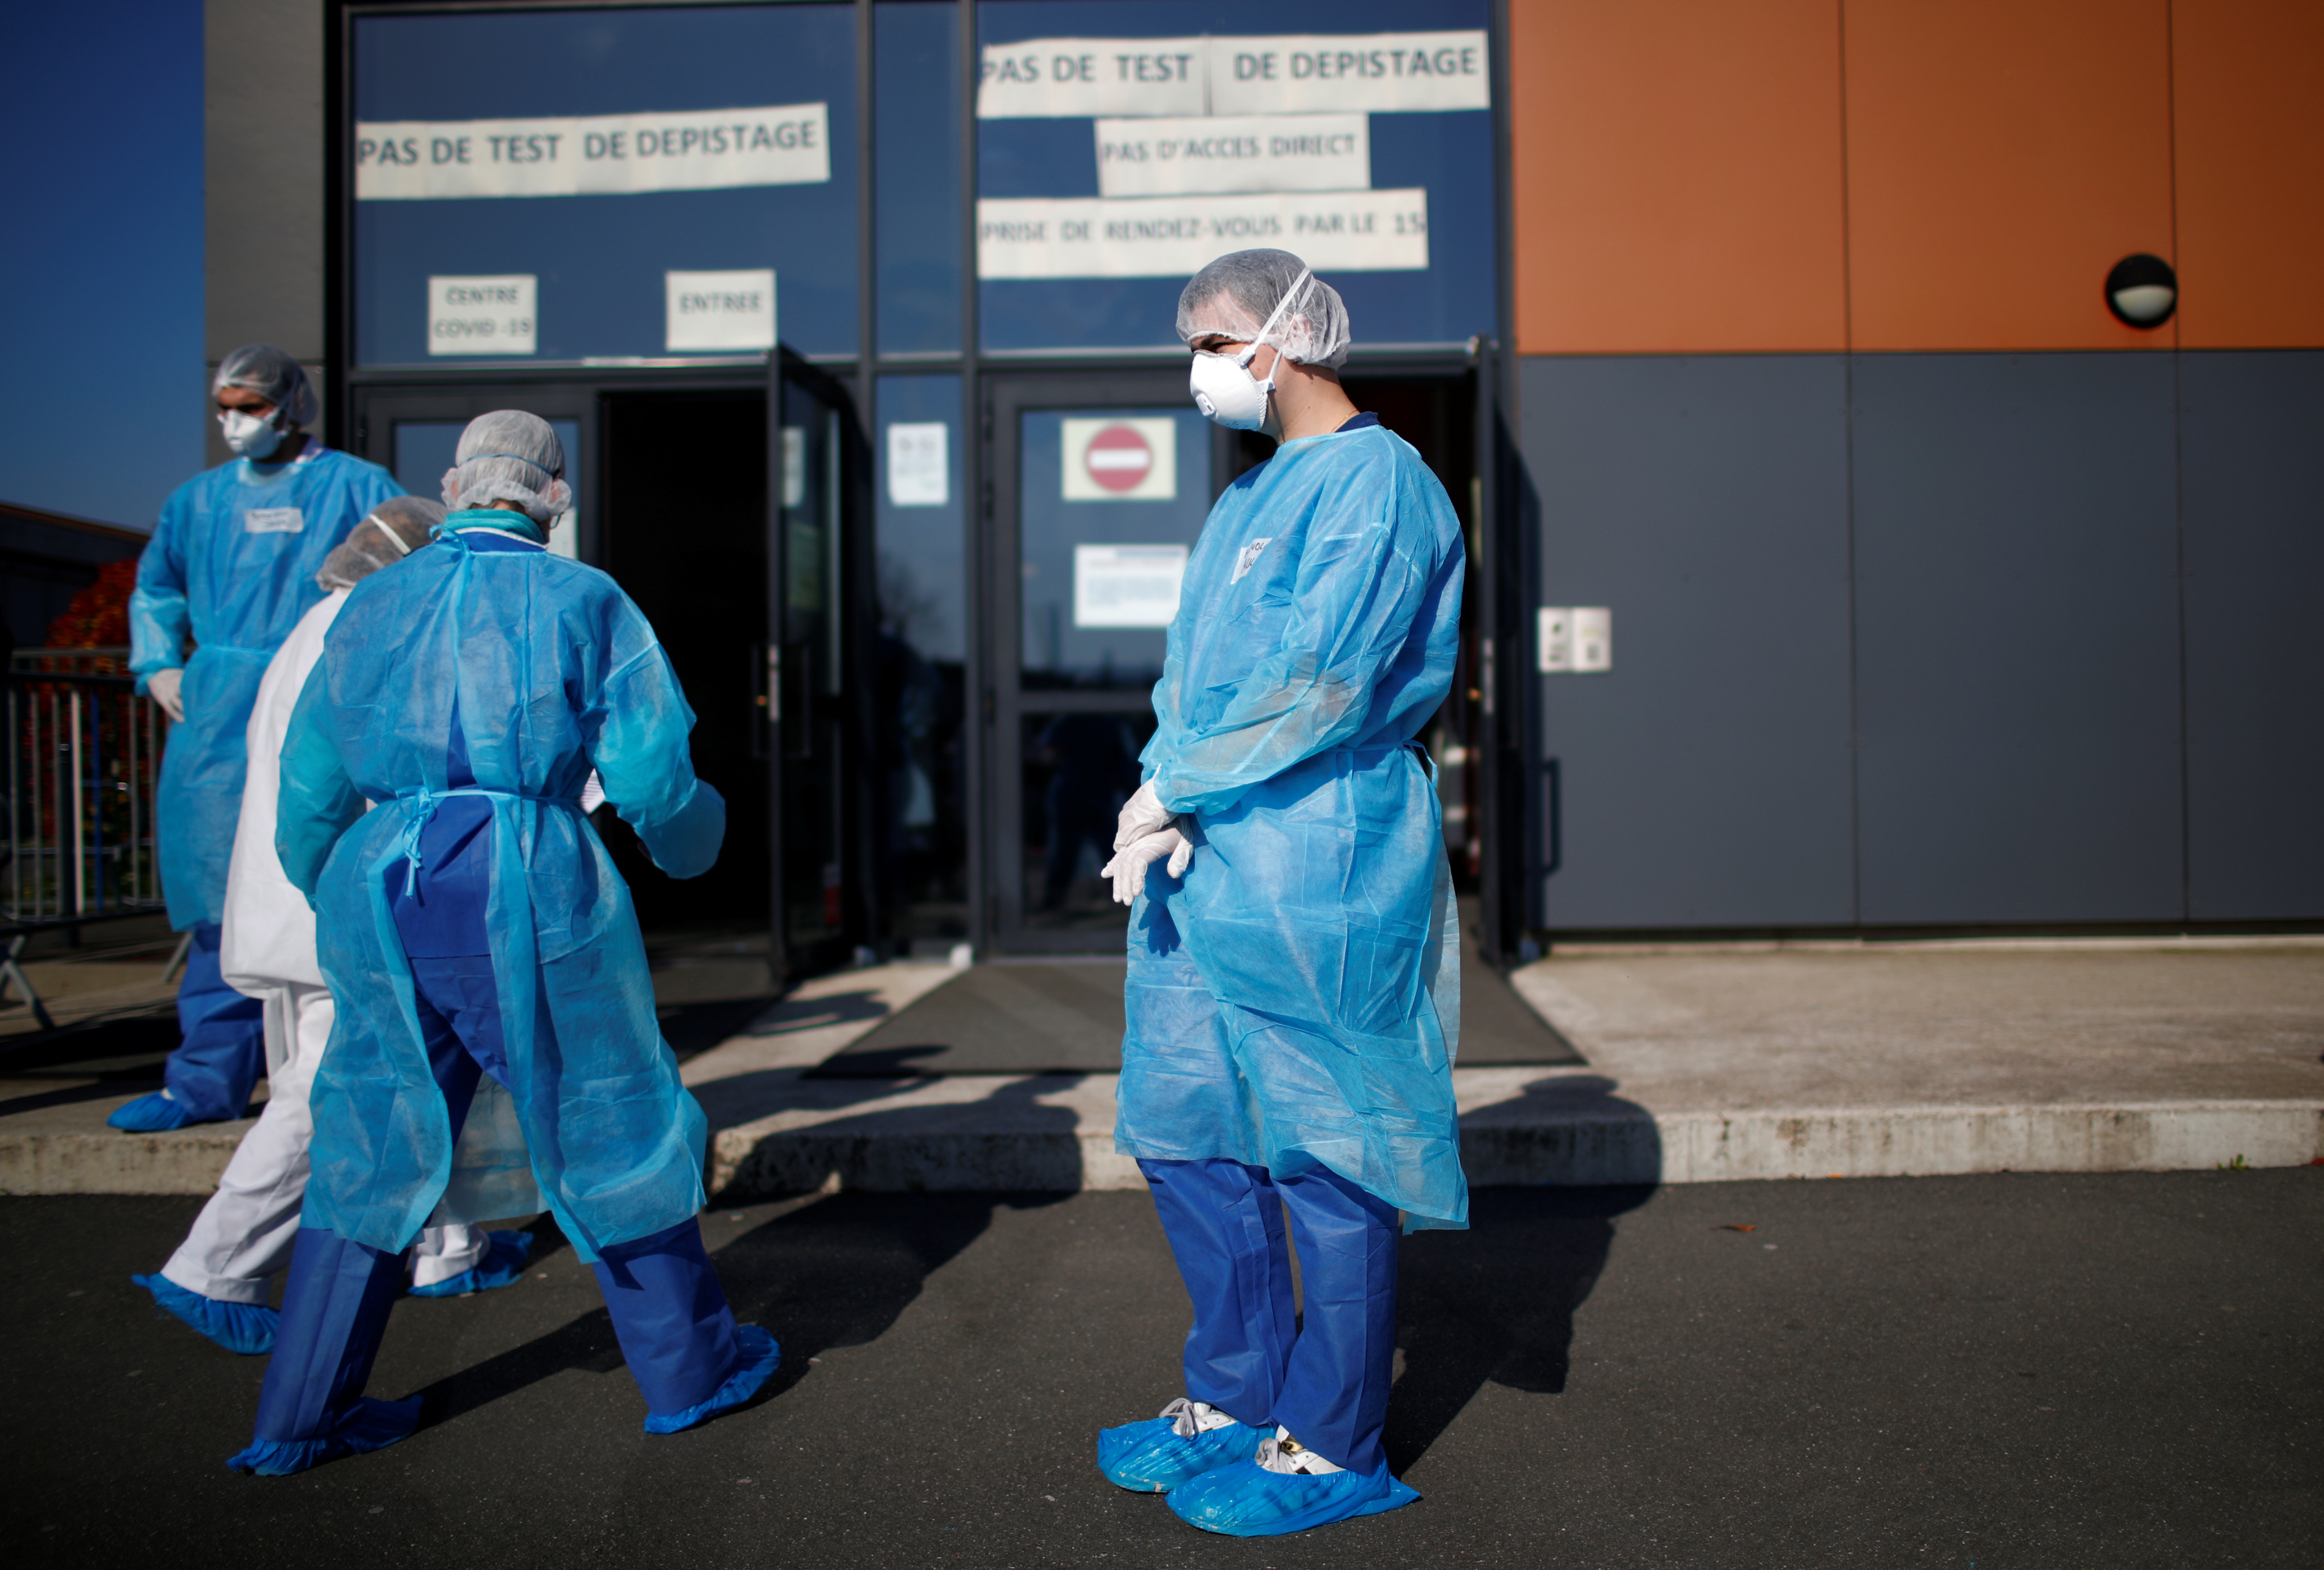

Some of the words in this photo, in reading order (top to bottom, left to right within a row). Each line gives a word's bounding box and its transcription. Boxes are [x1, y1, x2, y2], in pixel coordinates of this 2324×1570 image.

[982, 55, 1039, 83] PAS
[1052, 54, 1096, 82] DE
[1113, 53, 1195, 82] TEST
[1234, 52, 1278, 80] DE
[1292, 47, 1477, 79] DEPISTAGE
[359, 138, 418, 165] PAS
[431, 136, 472, 164] DE
[487, 134, 562, 162] TEST
[584, 131, 627, 160] DE
[636, 120, 817, 157] DEPISTAGE
[1101, 140, 1149, 163] PAS
[1158, 135, 1260, 159] D'ACCES
[1270, 133, 1356, 157] DIRECT
[982, 220, 1049, 242] PRISE
[1061, 219, 1092, 241] DE
[1105, 214, 1282, 240] RENDEZ-VOUS
[1295, 212, 1345, 235] PAR
[1351, 212, 1377, 234] LE
[1394, 210, 1425, 235] 15
[446, 285, 519, 306] CENTRE
[680, 290, 762, 314] ENTREE
[435, 318, 496, 339] COVID
